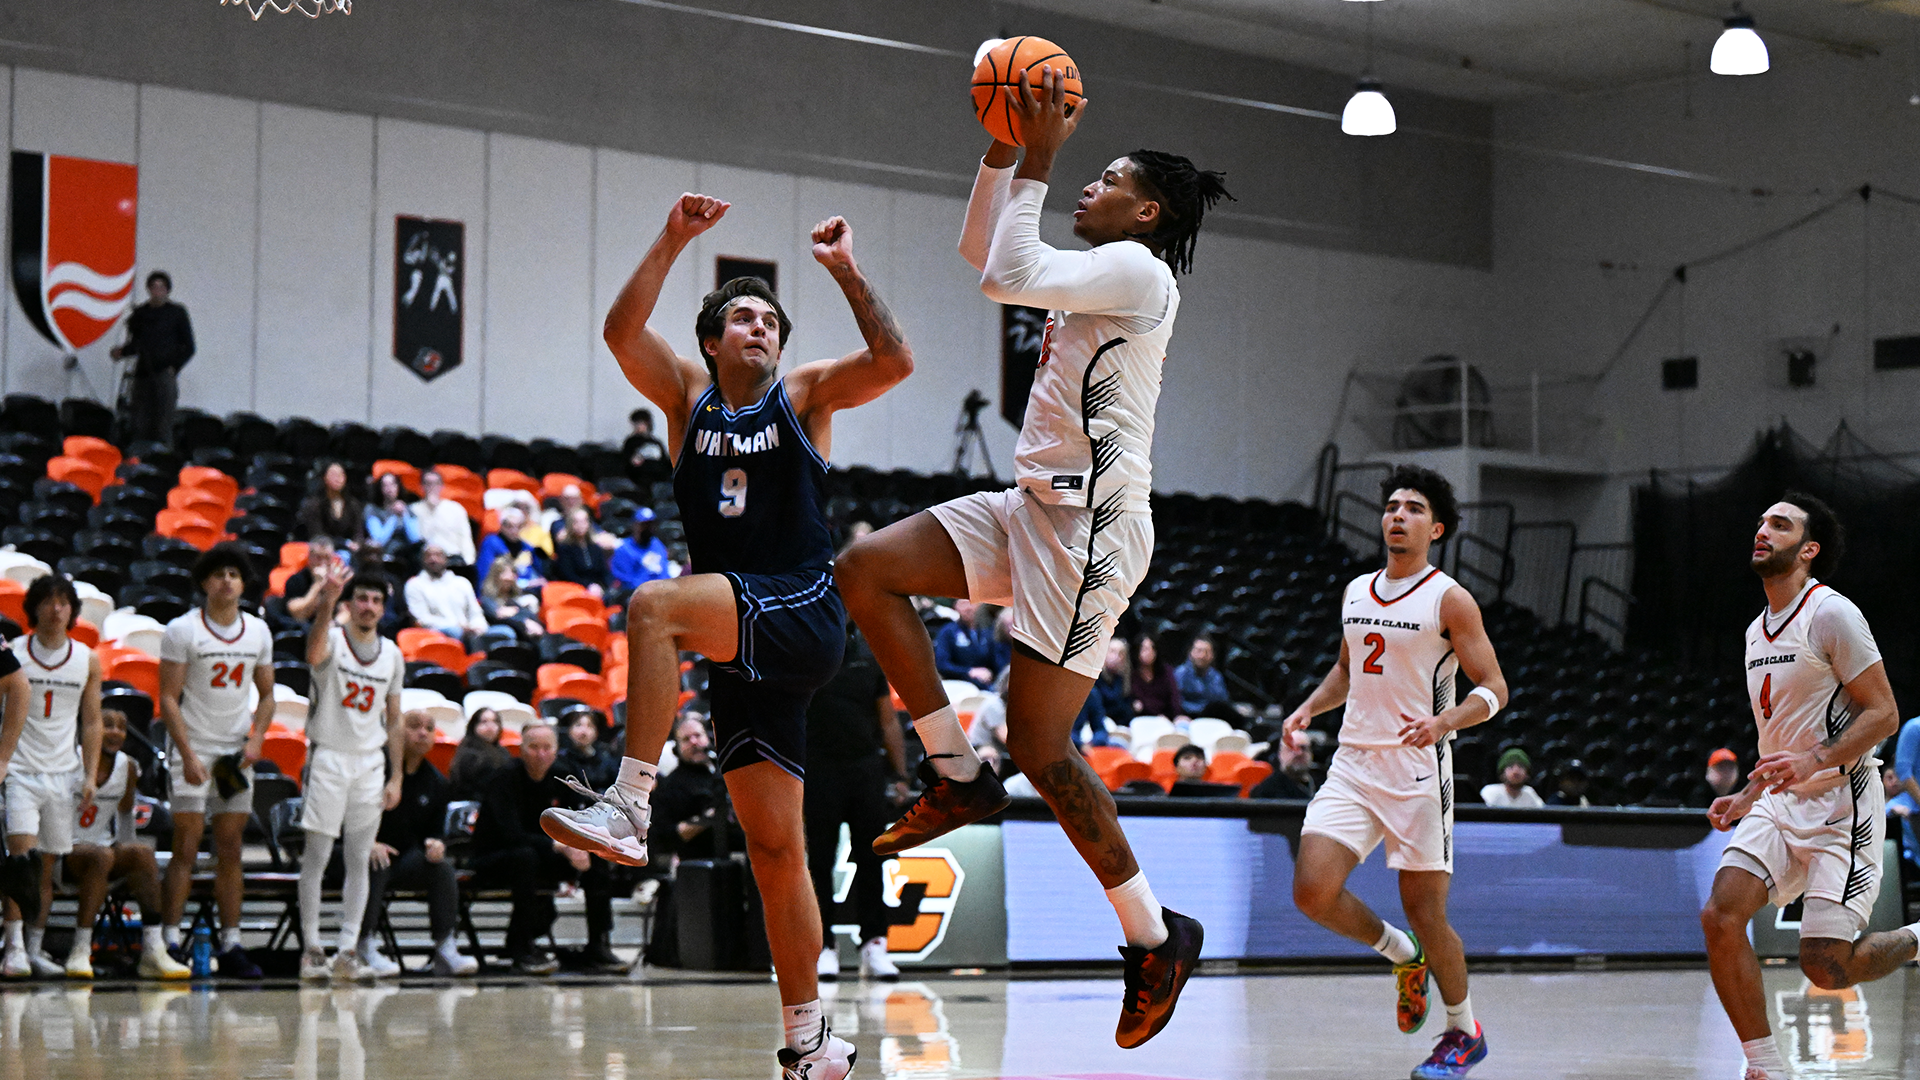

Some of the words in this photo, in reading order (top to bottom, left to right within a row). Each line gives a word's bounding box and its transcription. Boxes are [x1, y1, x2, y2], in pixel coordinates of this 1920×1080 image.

[718, 467, 747, 518] 9
[1382, 620, 1420, 630] CLARK
[1363, 632, 1385, 674] 2
[1770, 654, 1796, 664] CLARK
[211, 661, 245, 688] 24
[43, 690, 54, 719] 1
[341, 681, 376, 713] 23
[1760, 673, 1772, 719] 4
